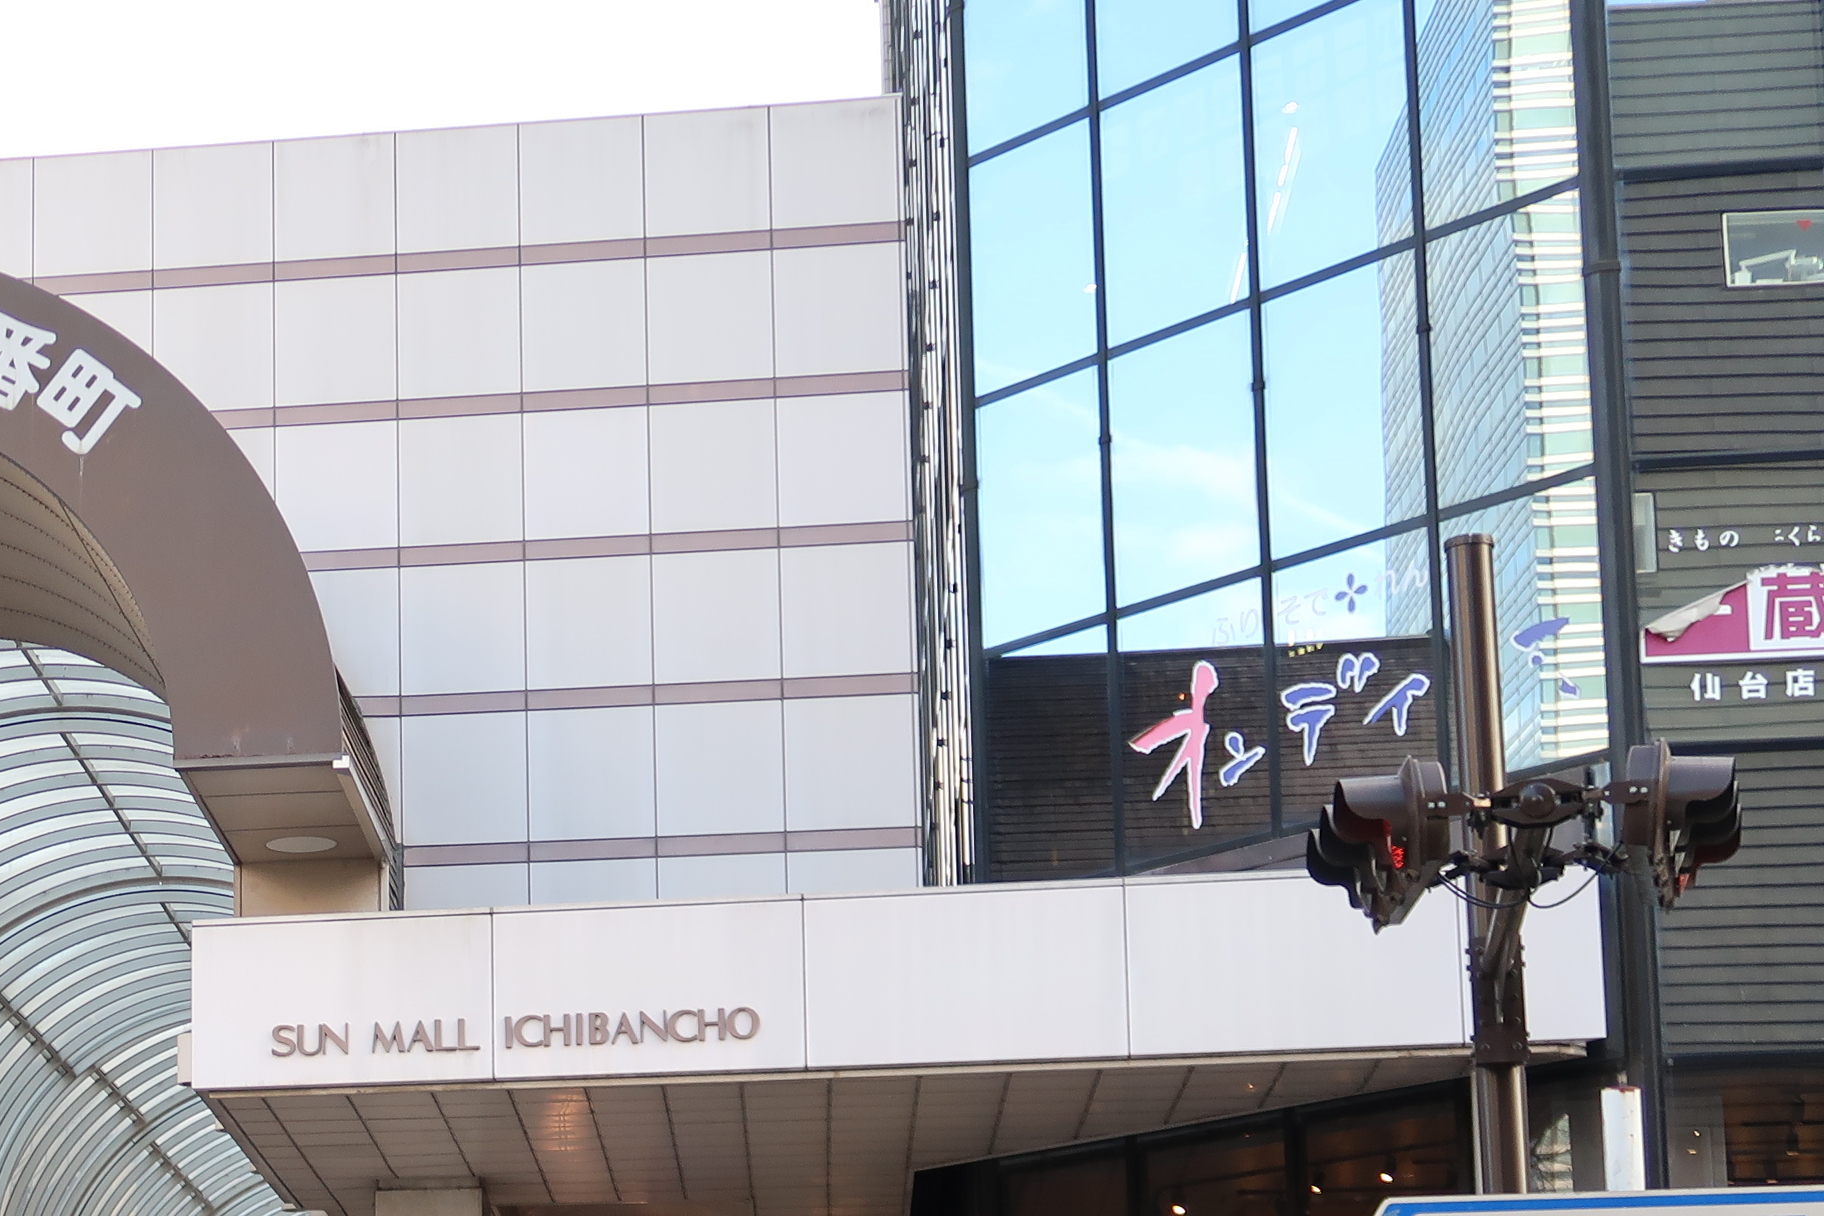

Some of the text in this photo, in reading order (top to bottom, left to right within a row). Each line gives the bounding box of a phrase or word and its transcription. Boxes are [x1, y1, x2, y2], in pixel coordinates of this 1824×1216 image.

[1668, 529, 1739, 553] きもの
[1690, 668, 1816, 702] 仙台店
[271, 1005, 761, 1057] SUN MALL ICHIBANCHO
